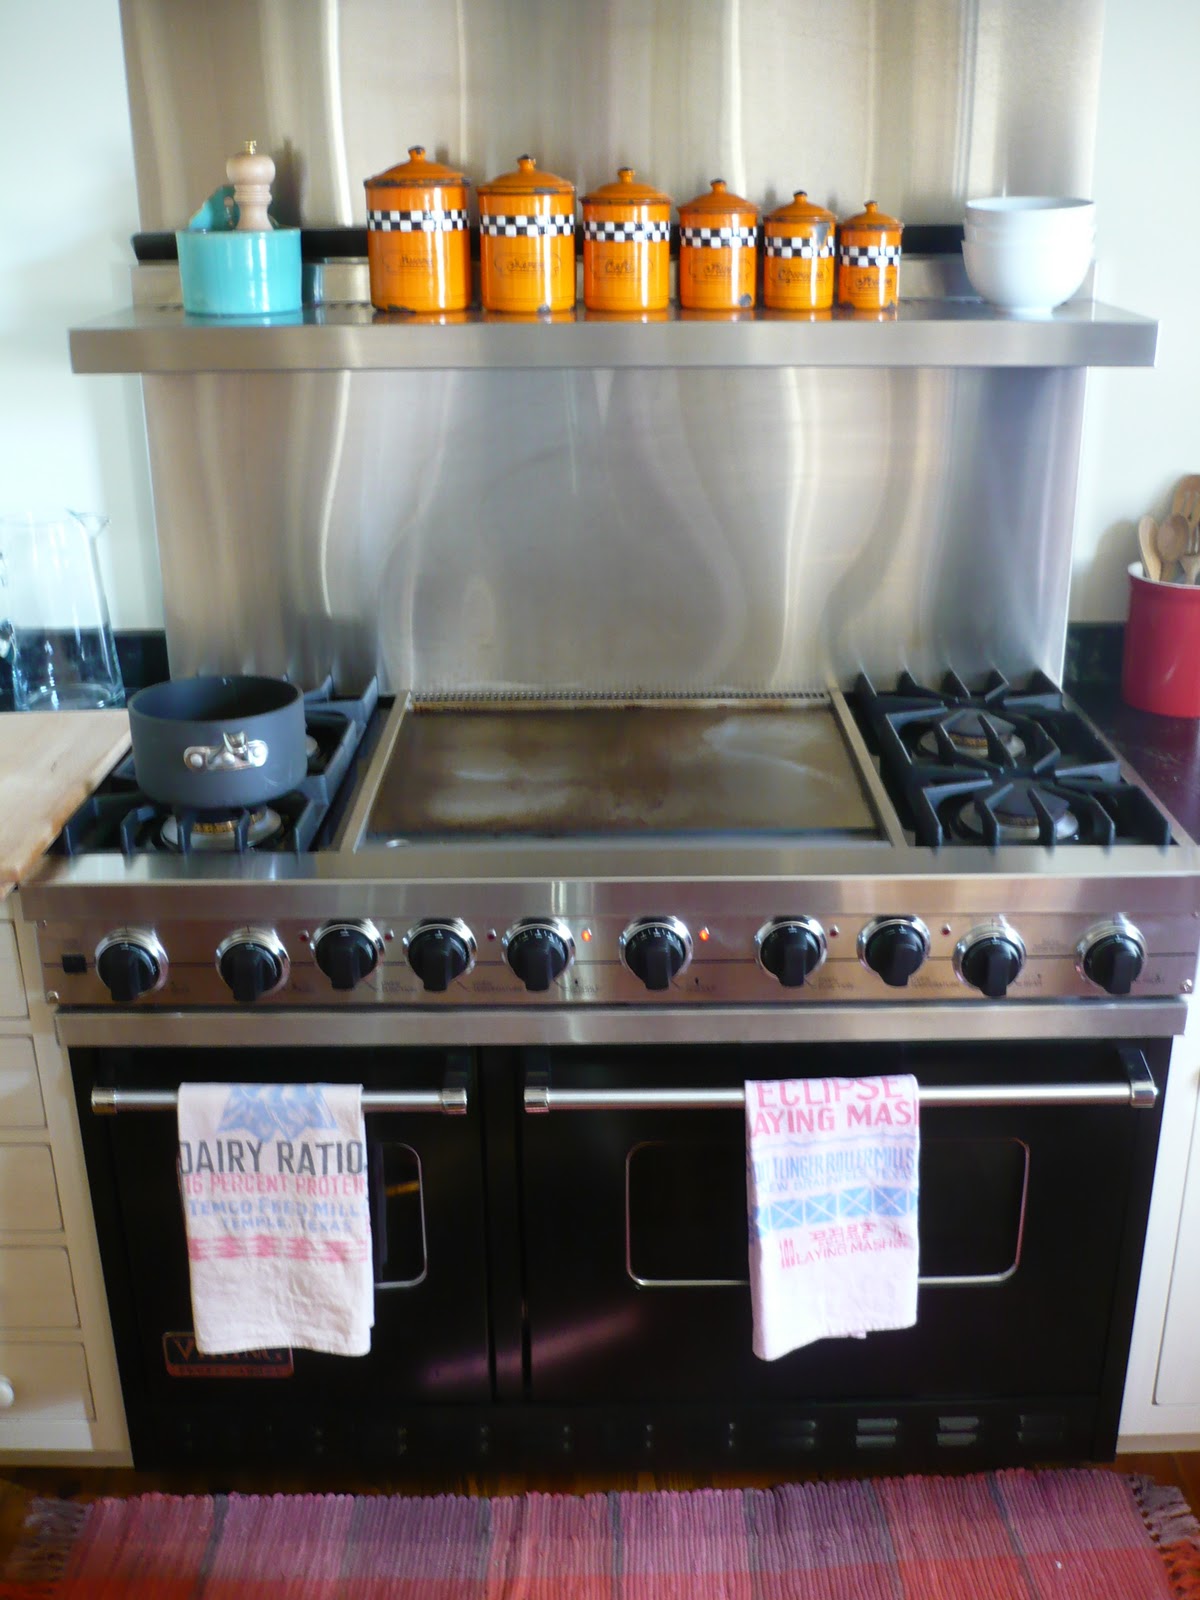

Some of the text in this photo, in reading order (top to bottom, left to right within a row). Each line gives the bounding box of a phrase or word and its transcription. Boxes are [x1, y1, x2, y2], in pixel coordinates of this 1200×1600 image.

[756, 1077, 903, 1109] ECLIPSE
[179, 1139, 263, 1174] DAIRY
[184, 1174, 204, 1195] 16
[210, 1173, 288, 1197] PERCENT
